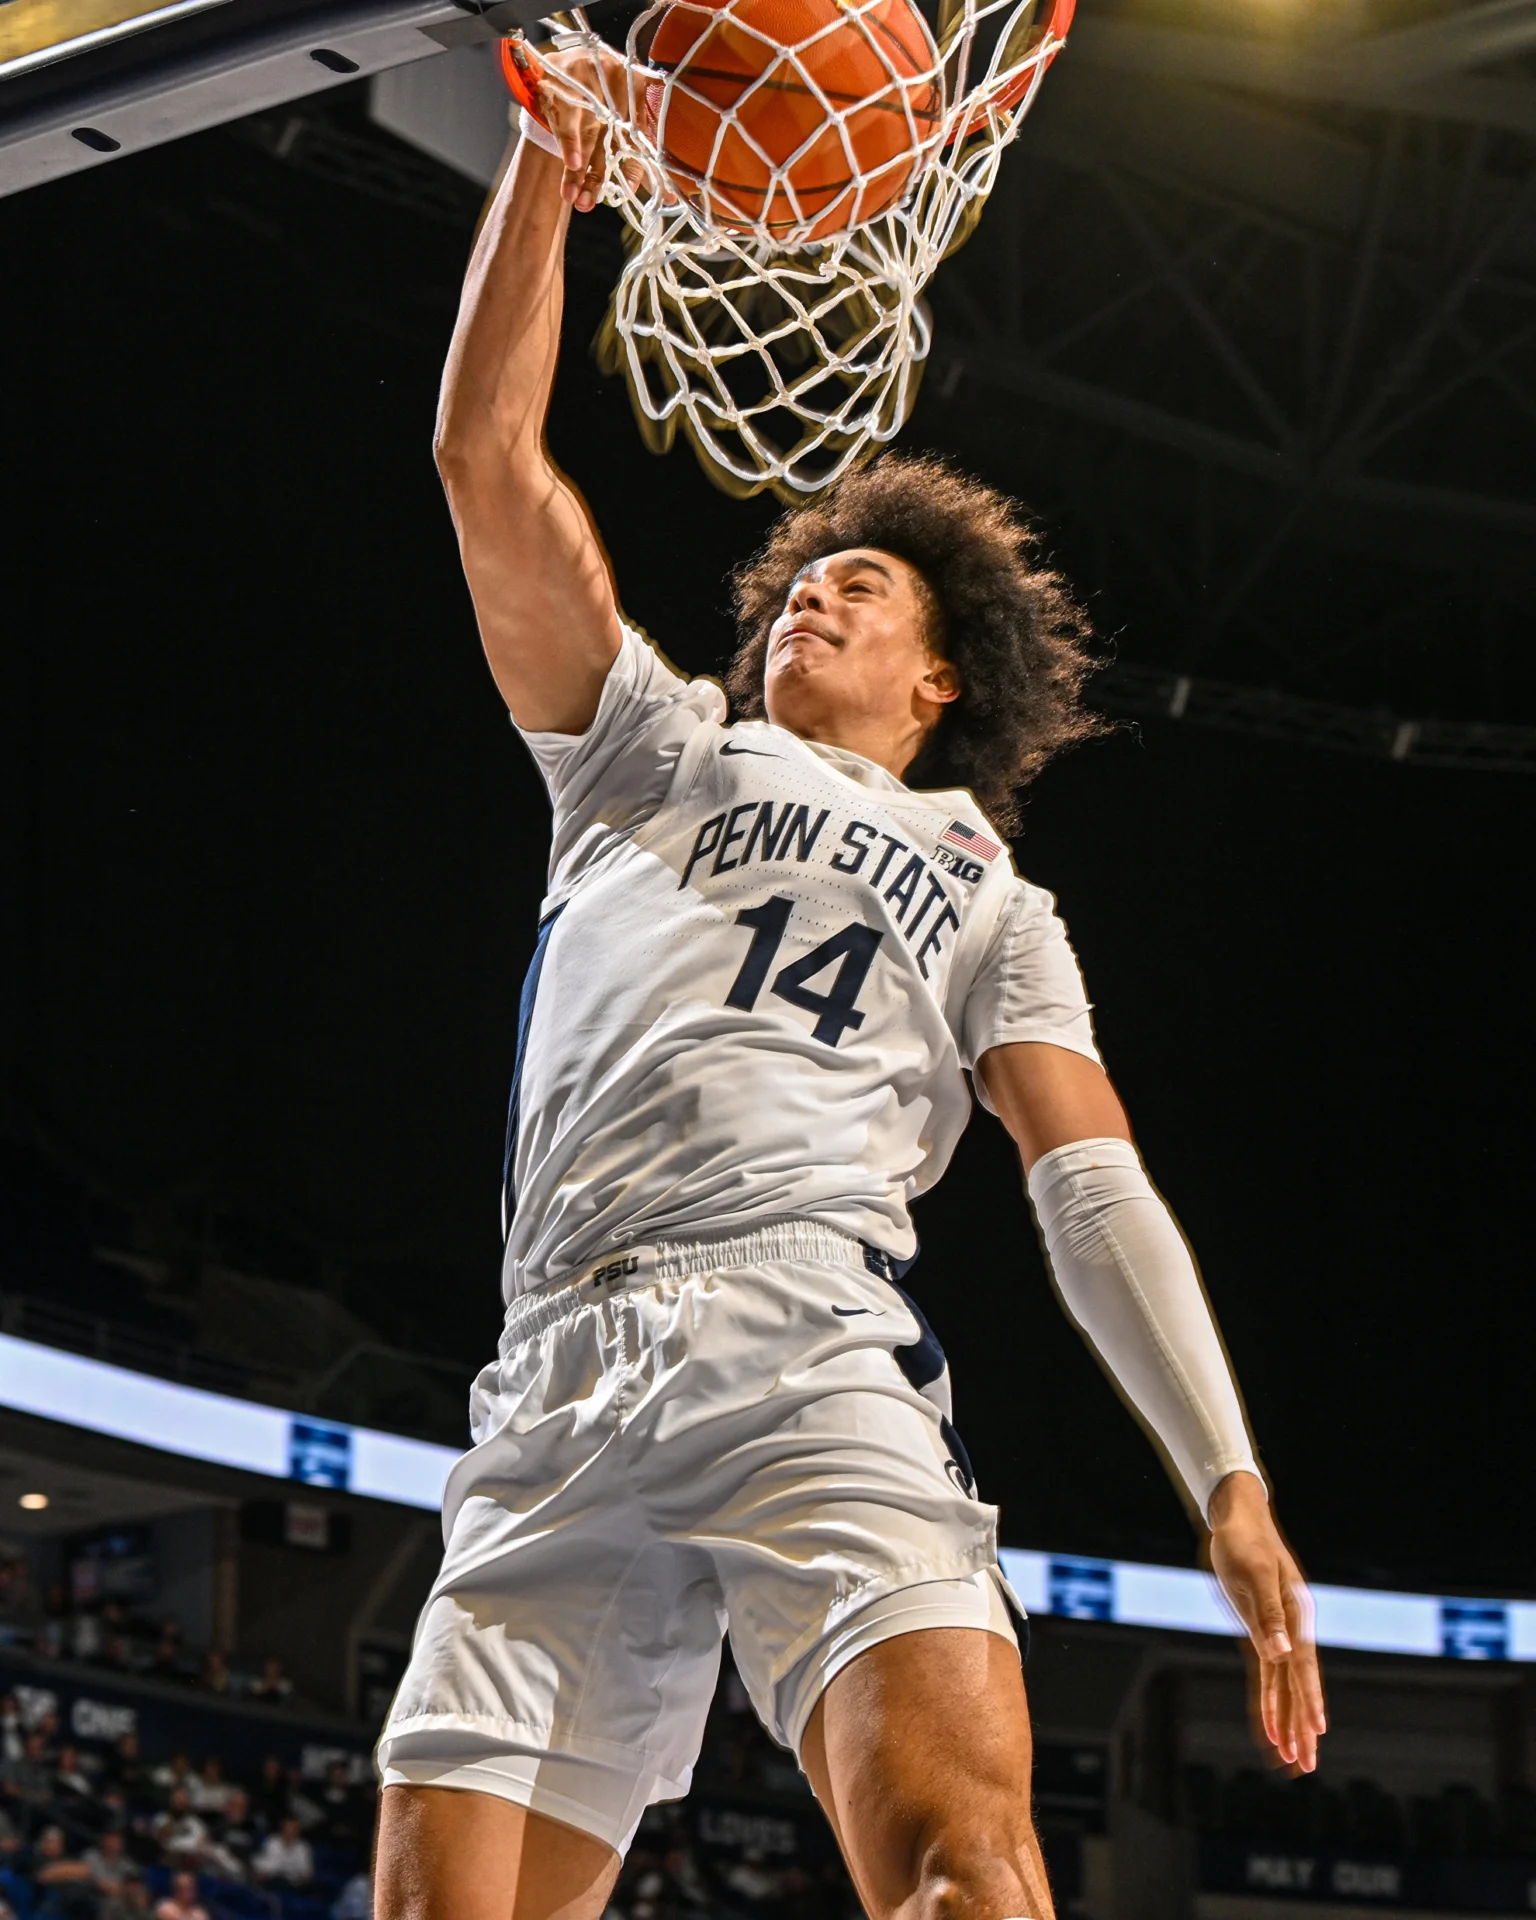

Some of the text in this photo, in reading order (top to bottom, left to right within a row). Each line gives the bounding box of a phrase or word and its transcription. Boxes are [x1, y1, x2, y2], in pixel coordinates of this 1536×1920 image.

[677, 800, 960, 981] PENN STATE
[724, 894, 885, 1048] 14
[592, 1256, 640, 1288] PSU
